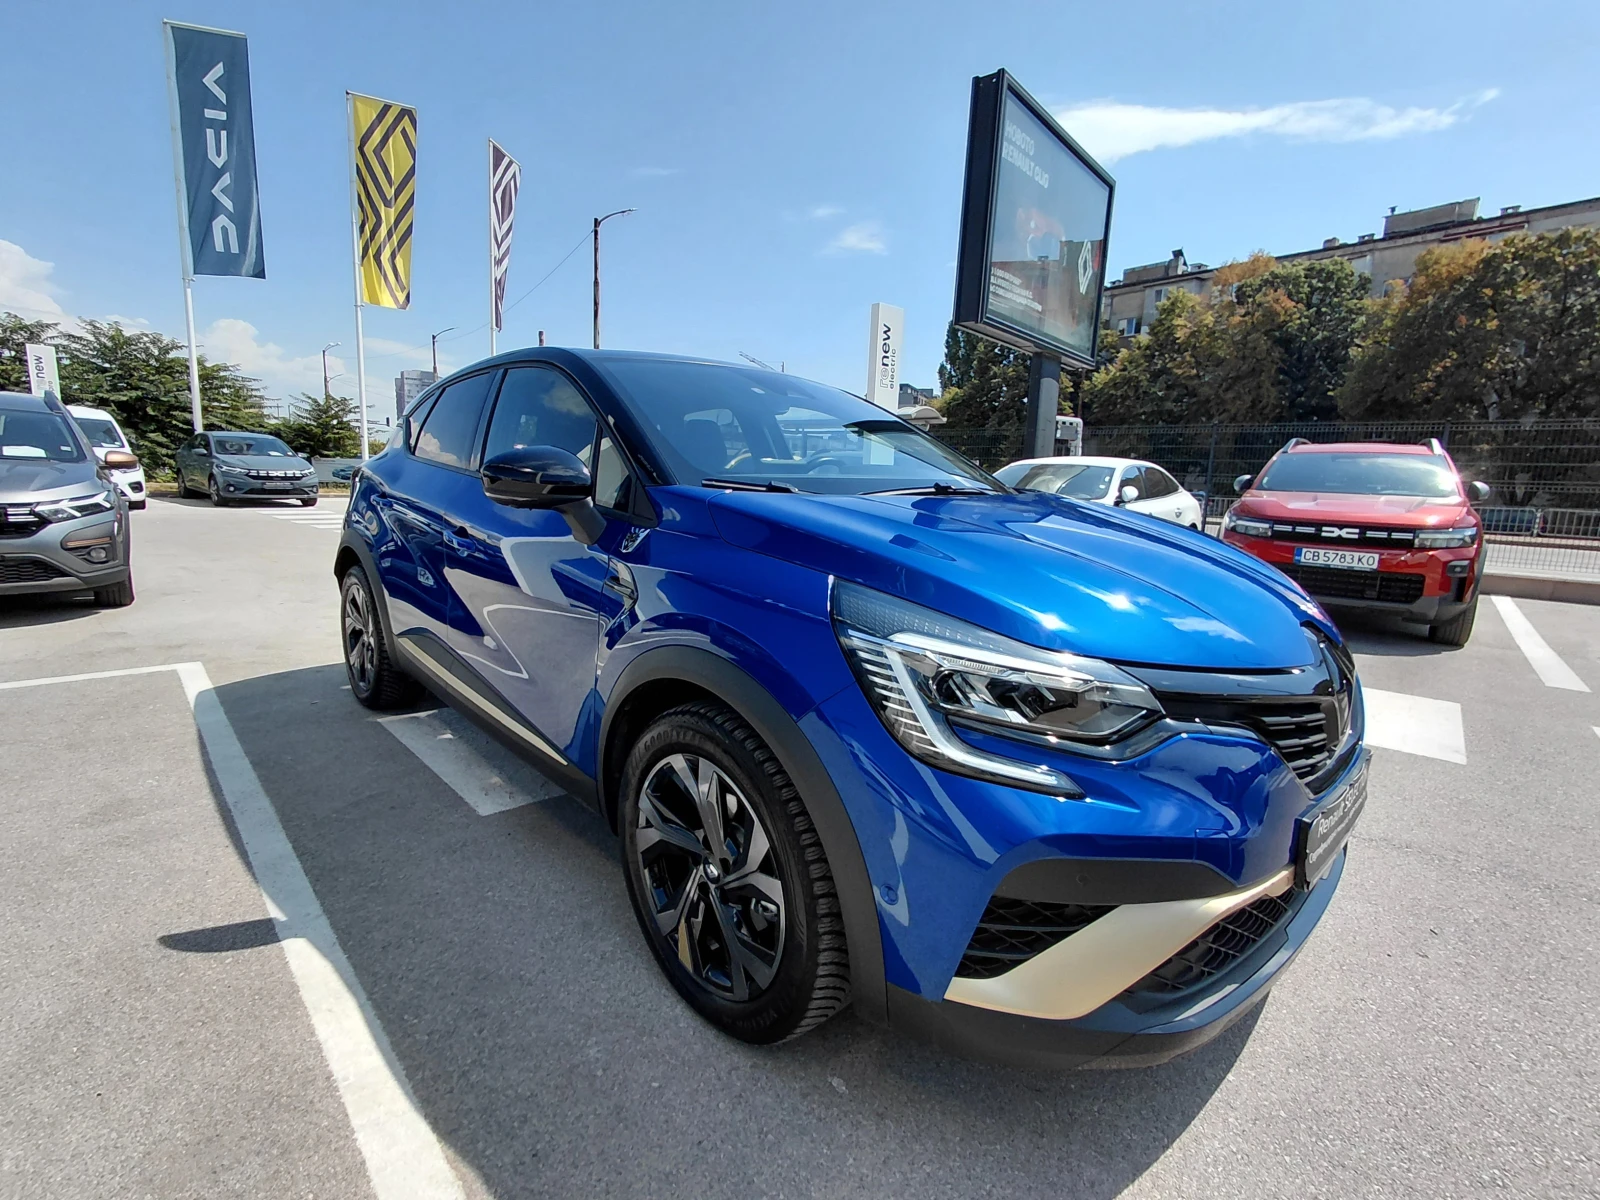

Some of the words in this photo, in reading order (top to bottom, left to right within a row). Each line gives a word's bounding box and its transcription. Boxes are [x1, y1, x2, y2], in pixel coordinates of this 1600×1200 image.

[202, 61, 240, 254] DACIA
[880, 323, 891, 389] renew
[889, 348, 897, 390] electric
[1322, 551, 1355, 565] 5783
